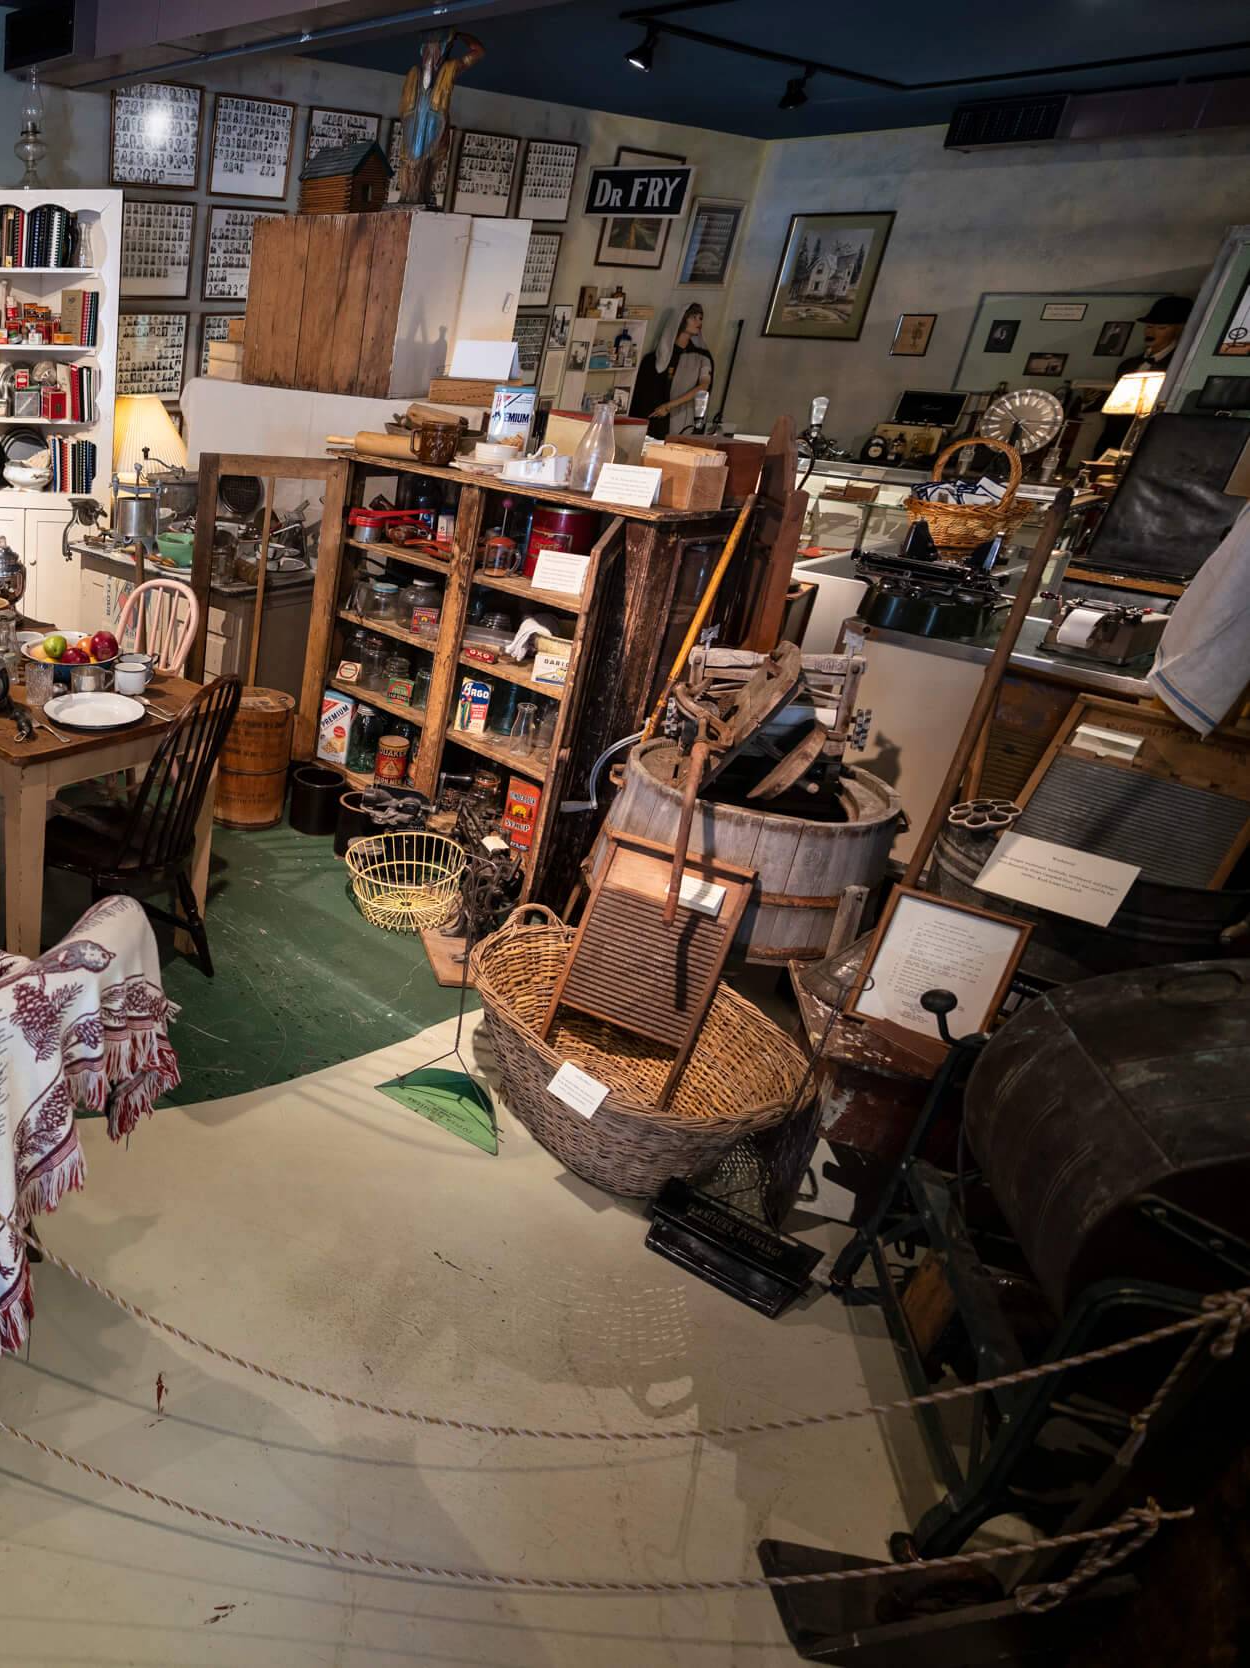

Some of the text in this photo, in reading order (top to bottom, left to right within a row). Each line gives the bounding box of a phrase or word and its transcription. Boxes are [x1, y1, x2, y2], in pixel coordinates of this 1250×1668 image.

[628, 176, 682, 207] FRY
[469, 648, 490, 660] OXO
[462, 682, 490, 699] ARGO
[321, 704, 350, 728] PREMIUM
[504, 817, 531, 833] SYRUP
